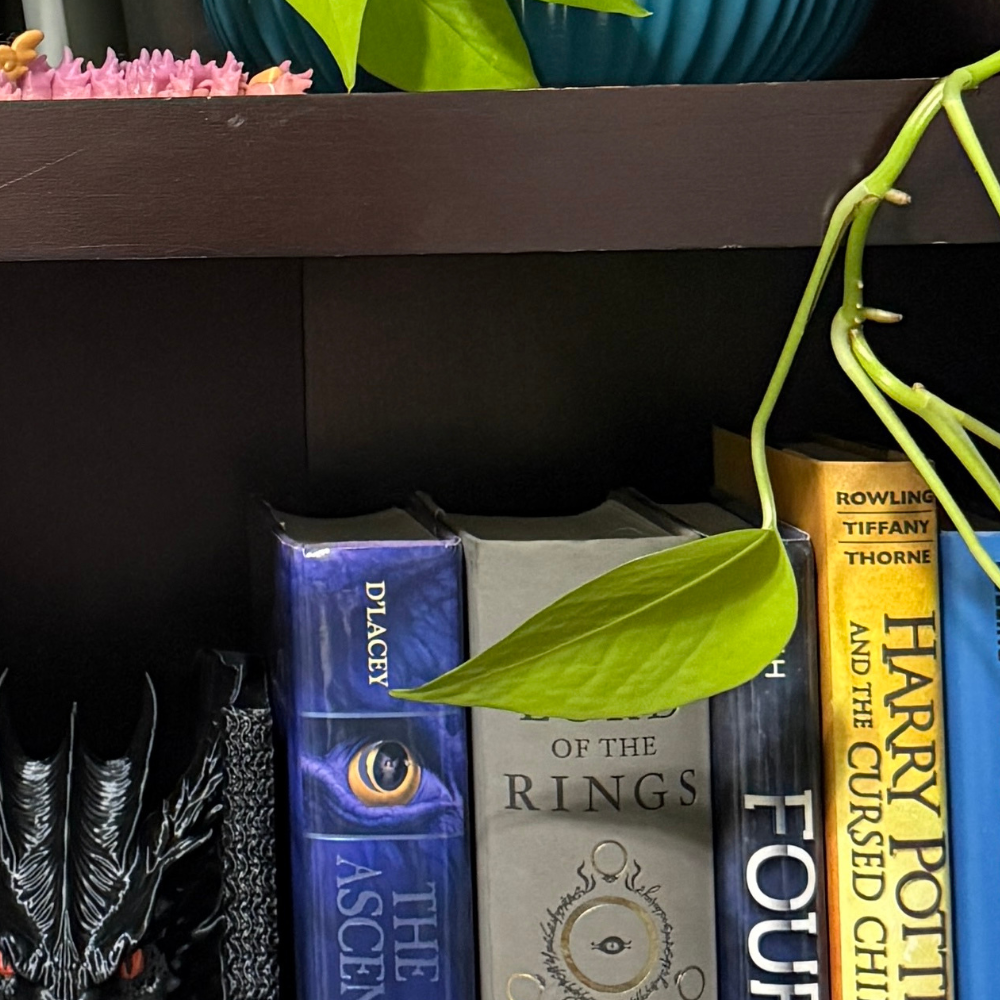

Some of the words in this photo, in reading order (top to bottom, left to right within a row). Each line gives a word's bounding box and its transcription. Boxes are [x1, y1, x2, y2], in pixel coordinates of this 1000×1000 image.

[836, 489, 935, 506] ROWLING
[843, 519, 930, 535] TIFFANY
[844, 549, 931, 565] THORNE
[365, 580, 390, 688] D'LACEY
[849, 620, 870, 676] AND
[852, 682, 873, 729] THE
[882, 609, 942, 818] HARRY
[551, 737, 590, 759] OF
[598, 736, 658, 758] THE
[503, 769, 697, 812] RINGS
[847, 741, 886, 901] CURSED
[392, 881, 441, 983] THE
[889, 831, 948, 1000] POTT
[854, 916, 889, 1000] CHI
